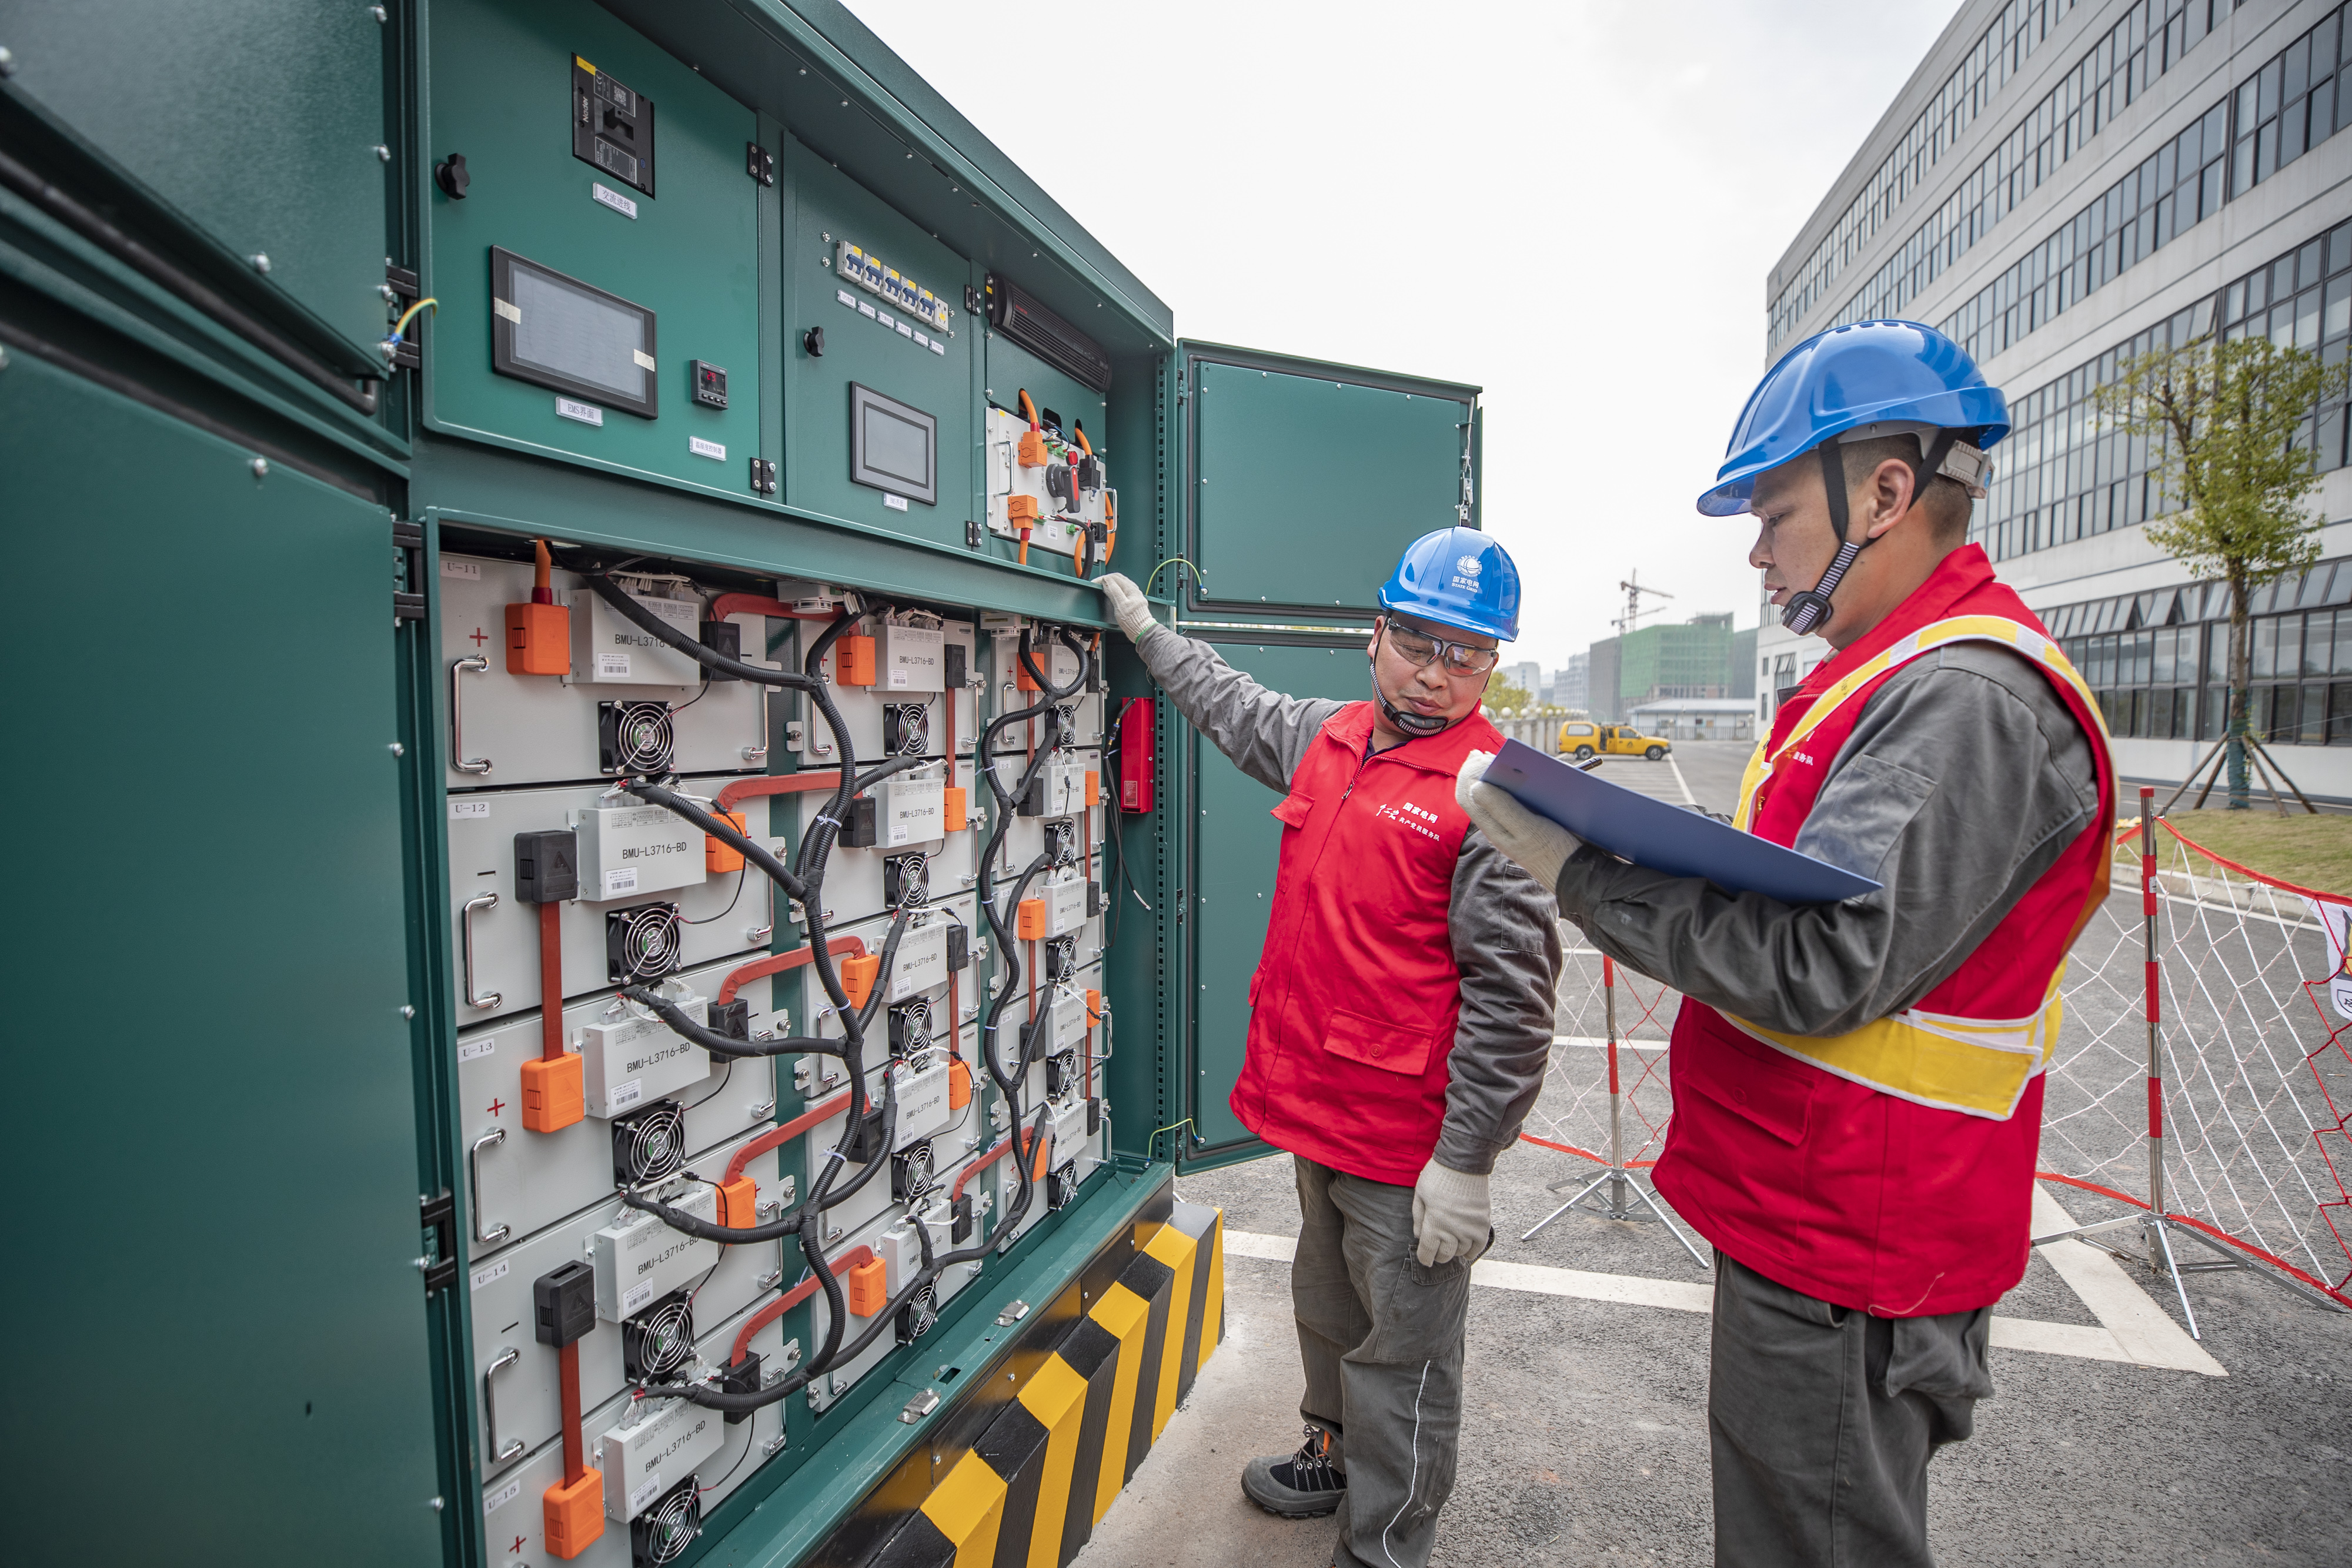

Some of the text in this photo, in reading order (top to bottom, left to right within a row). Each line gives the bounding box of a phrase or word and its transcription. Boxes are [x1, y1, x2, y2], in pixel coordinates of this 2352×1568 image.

[602, 189, 631, 212] 交流进线
[567, 403, 594, 419] EMS界面
[696, 441, 722, 455] 温湿度控制器
[447, 562, 477, 574] U-11
[1452, 576, 1479, 589] 国家电网
[899, 656, 934, 665] BMU-L3716-BD
[455, 804, 485, 813] U-12
[900, 807, 934, 818] BMU-L3716-BD
[1402, 802, 1438, 824] 国家电网
[1398, 817, 1440, 841] 共产党员服务队
[622, 841, 687, 860] BMU-L3716-BD
[903, 953, 937, 972] BMU-L3716-BD
[462, 1042, 492, 1057] U-13
[627, 1042, 690, 1073] BMU-L3716-BD
[906, 1095, 940, 1120] BMU-L3716-BD
[478, 1264, 507, 1284] U-14
[646, 1420, 706, 1473] BMU-L3716-BD
[489, 1485, 516, 1509] U-15
